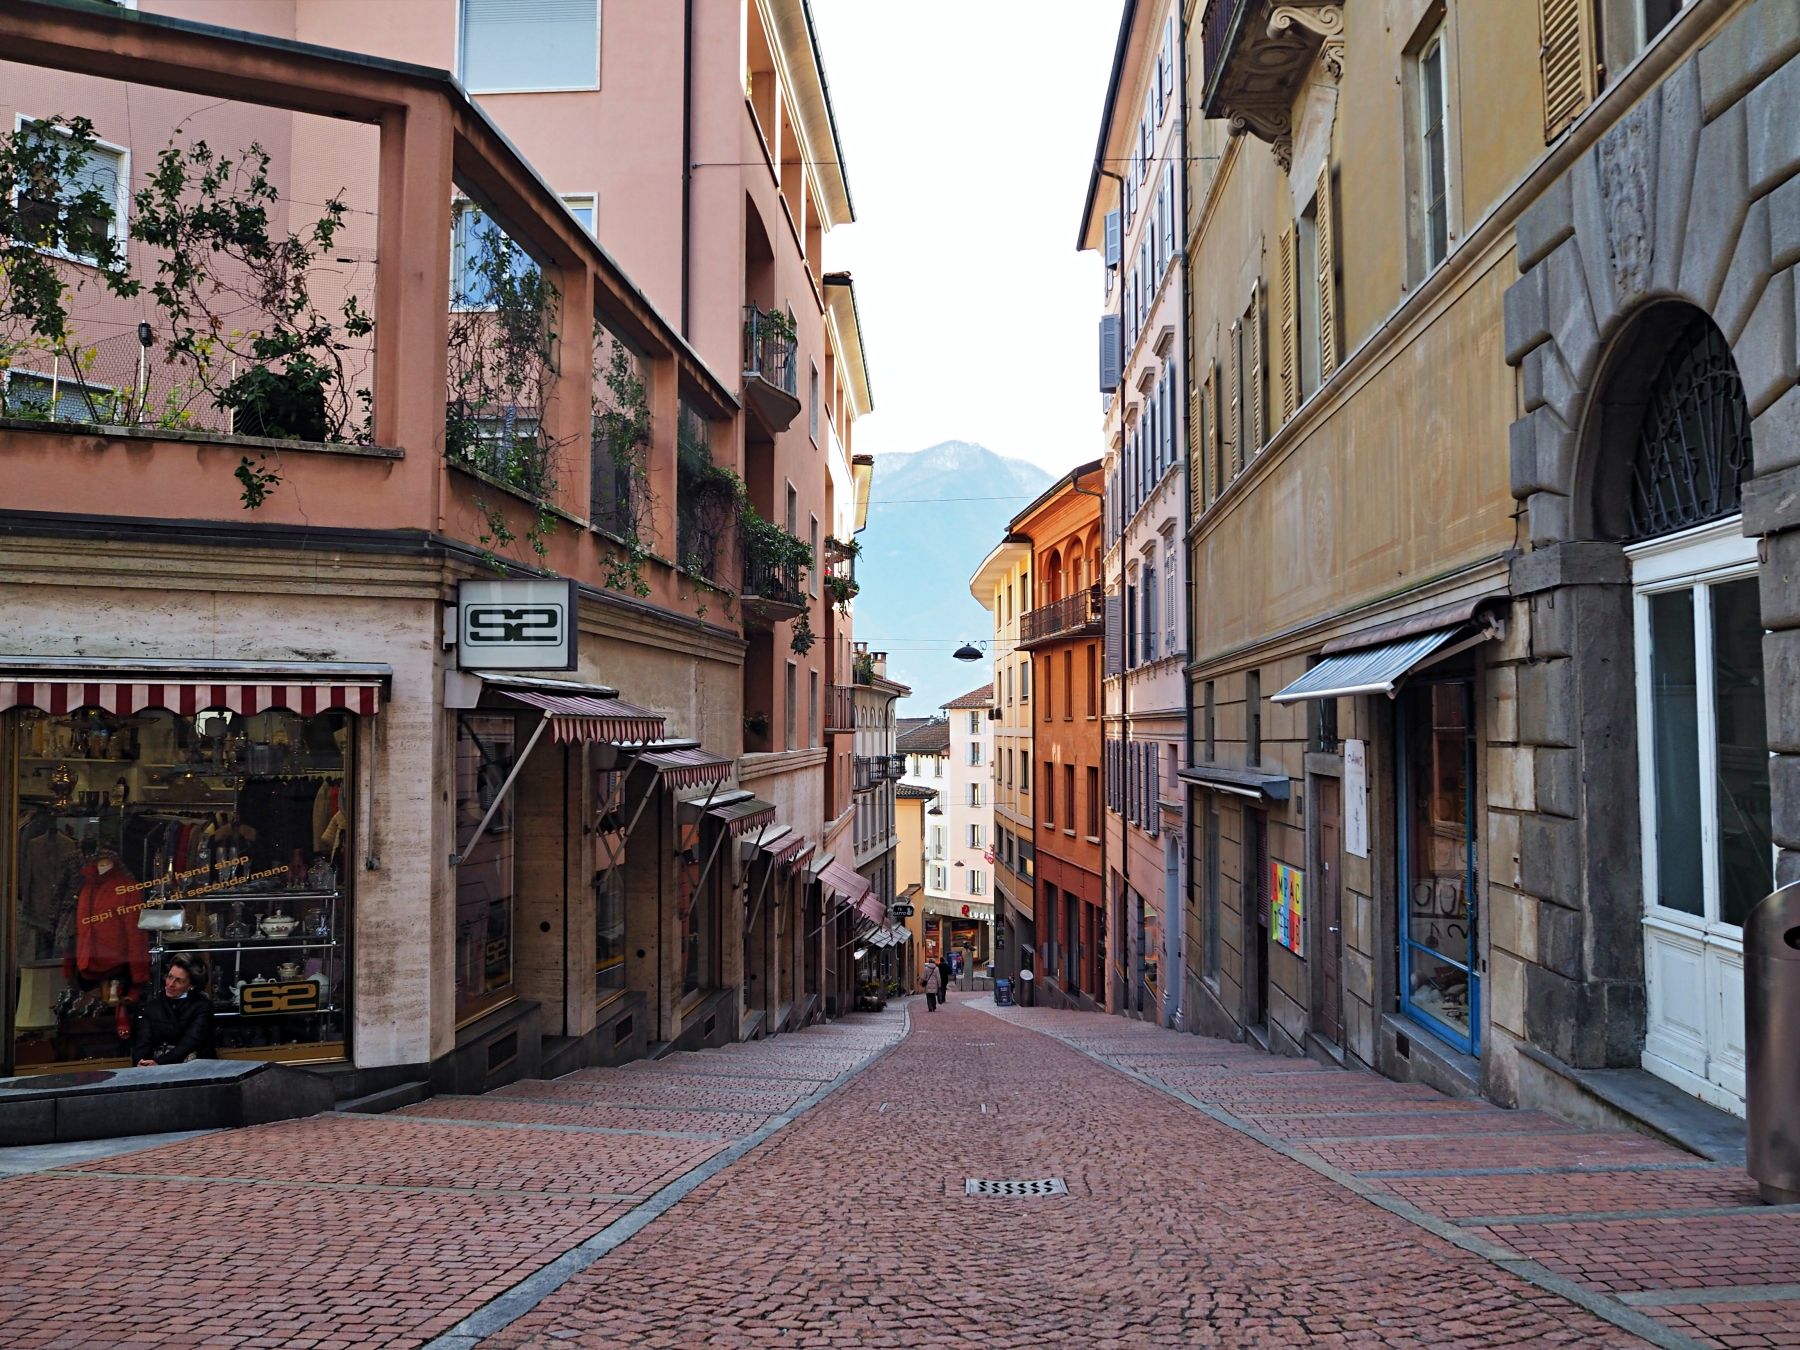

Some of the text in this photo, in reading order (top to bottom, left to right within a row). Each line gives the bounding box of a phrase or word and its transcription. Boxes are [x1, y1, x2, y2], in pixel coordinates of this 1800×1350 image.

[469, 608, 558, 642] S2
[114, 854, 250, 896] Second hand shop
[81, 909, 114, 926] capi
[170, 890, 183, 901] di
[187, 876, 247, 898] seconda
[250, 863, 290, 880] mano
[244, 983, 318, 1013] S2
